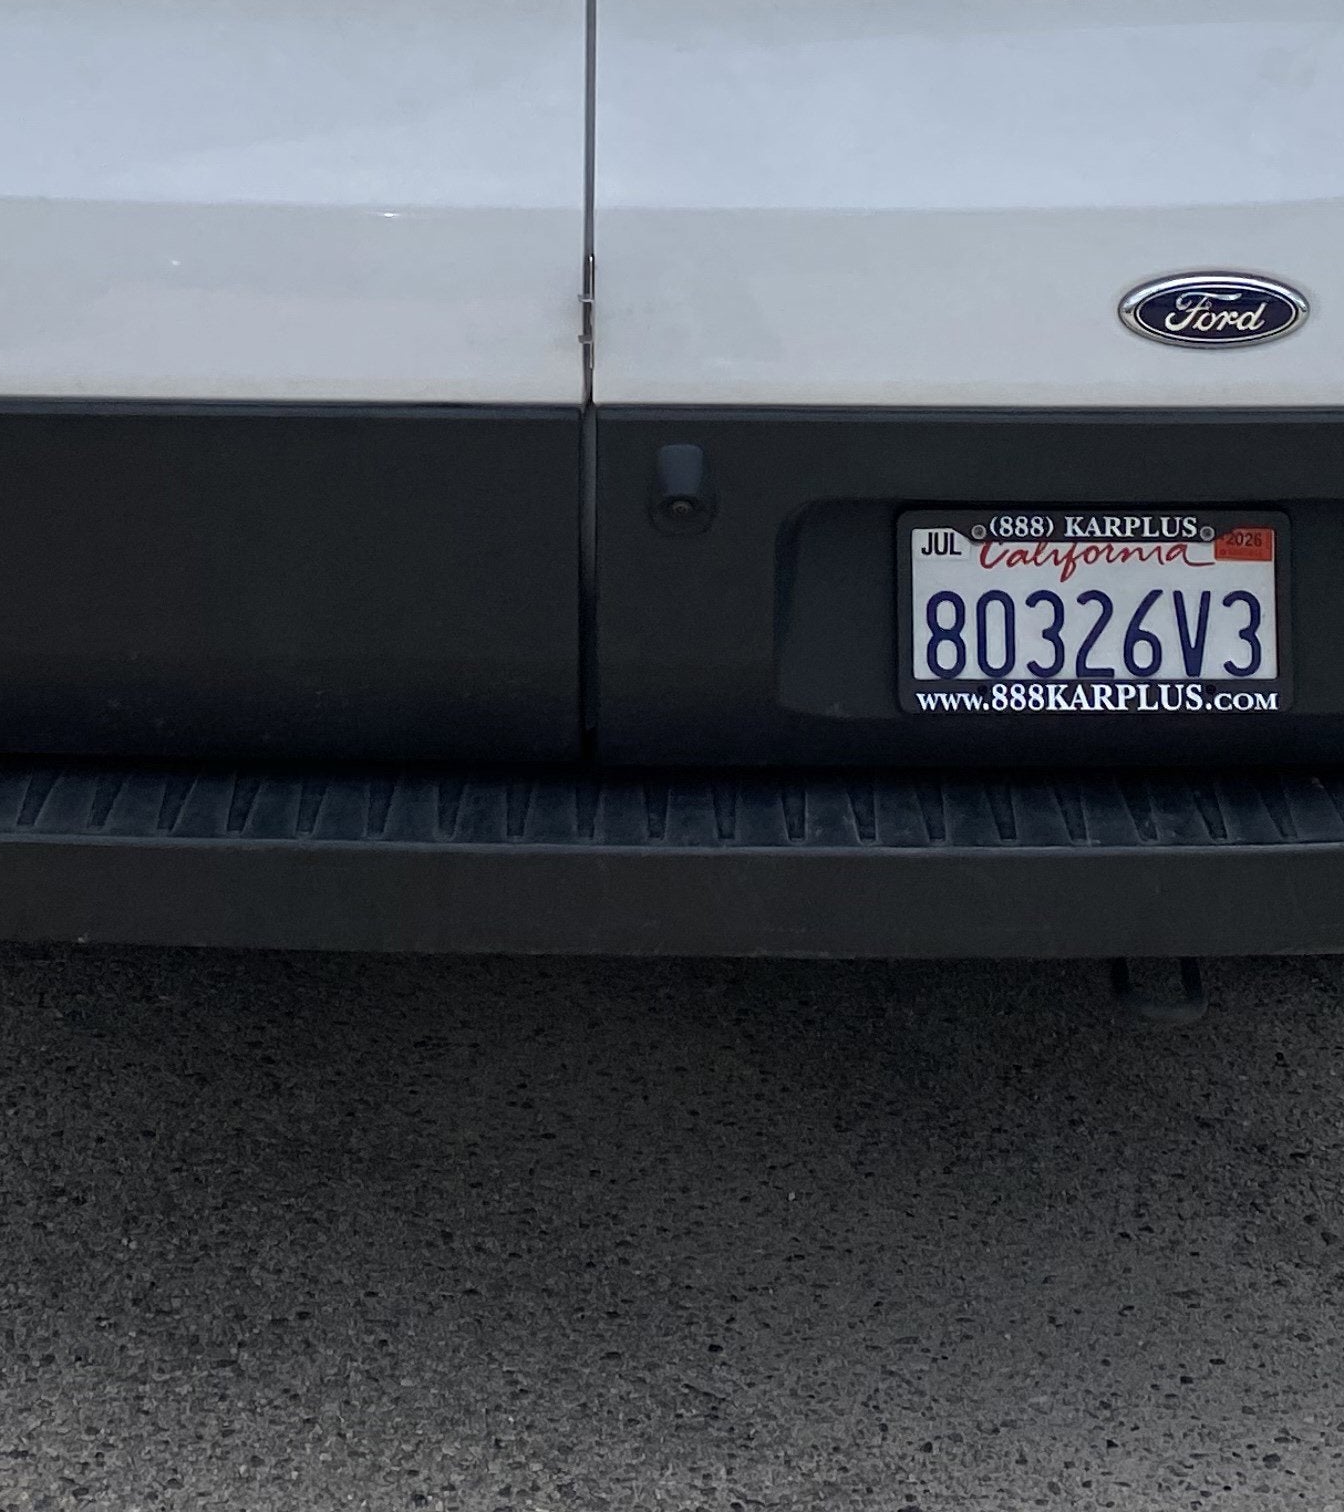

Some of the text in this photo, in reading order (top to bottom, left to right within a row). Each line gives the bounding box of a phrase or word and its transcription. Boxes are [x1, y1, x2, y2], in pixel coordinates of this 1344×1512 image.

[1164, 291, 1268, 331] Ford
[921, 531, 962, 556] JUL
[990, 516, 1197, 538] (888) KARPLUS
[979, 540, 1215, 582] California
[926, 589, 1262, 678] 80326V3
